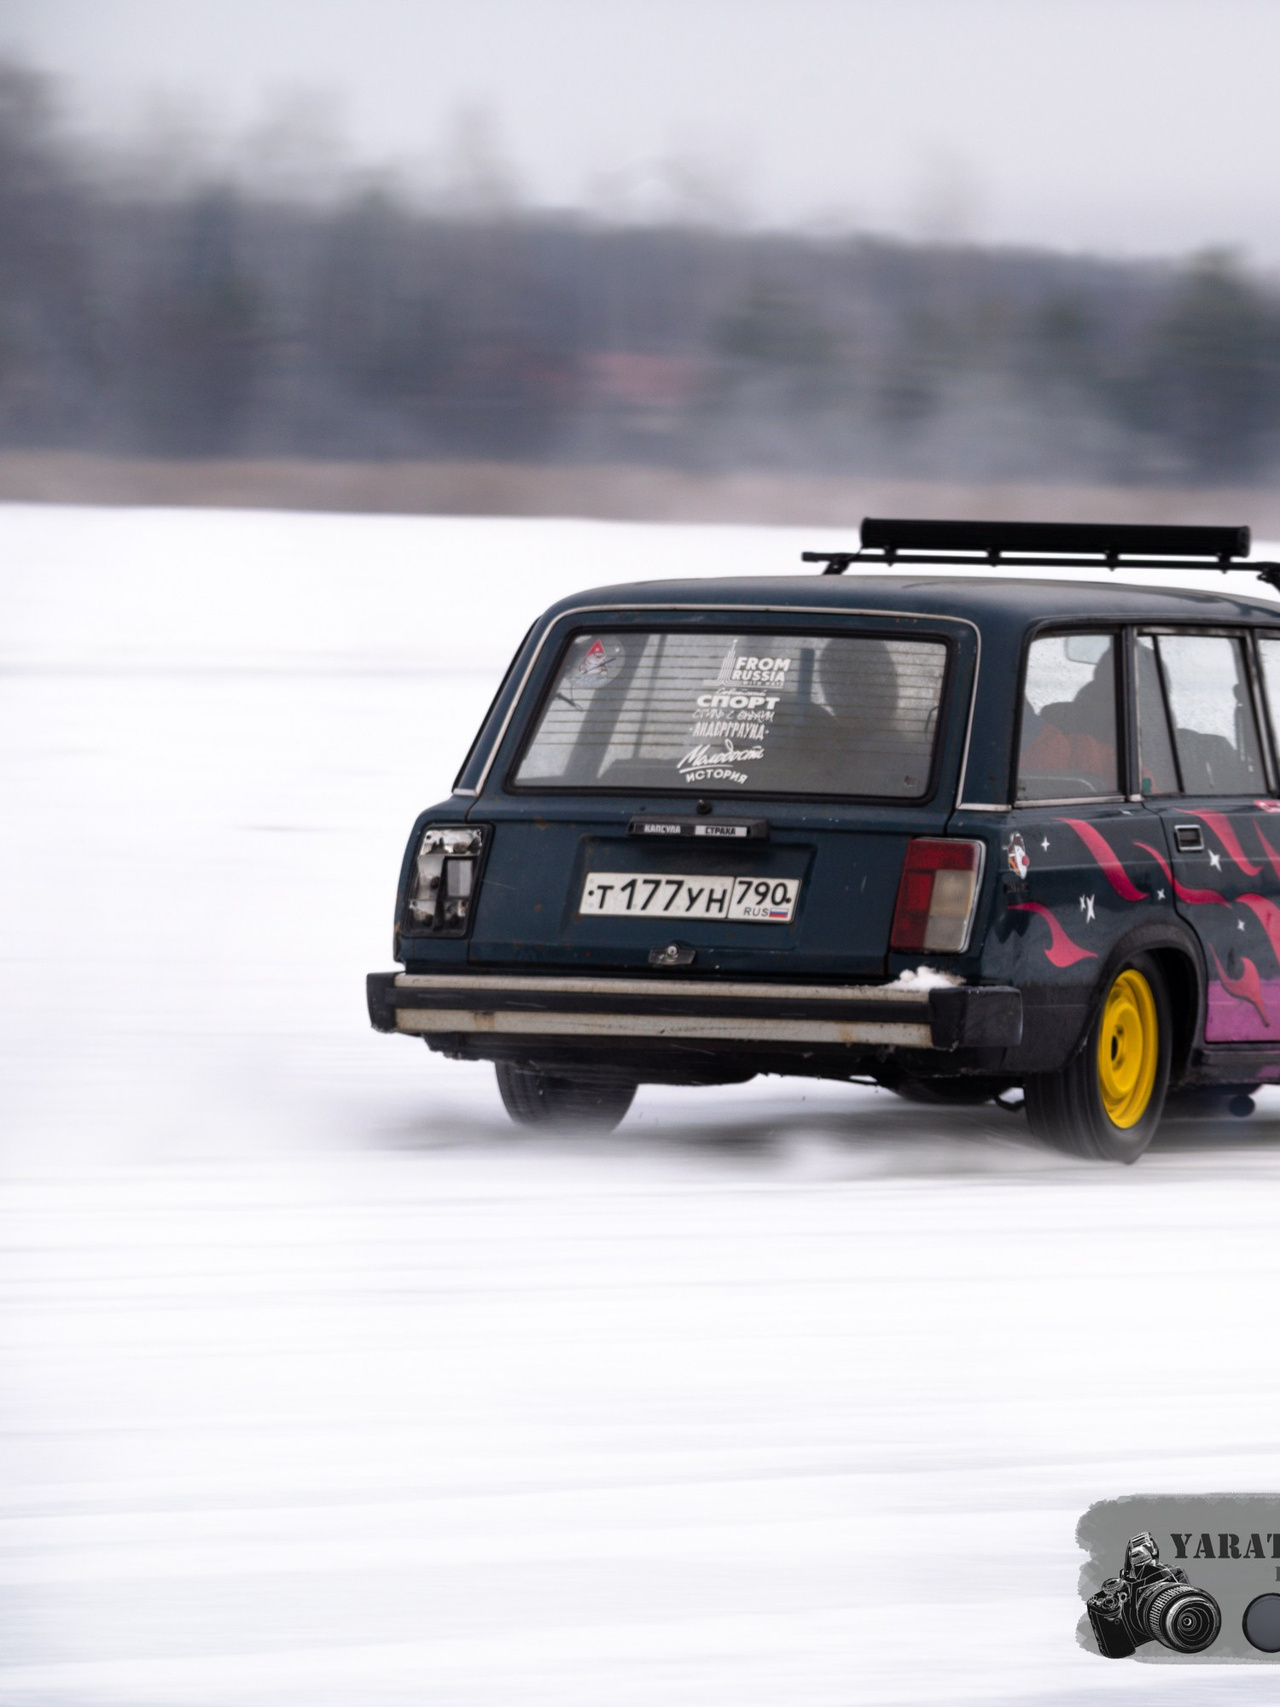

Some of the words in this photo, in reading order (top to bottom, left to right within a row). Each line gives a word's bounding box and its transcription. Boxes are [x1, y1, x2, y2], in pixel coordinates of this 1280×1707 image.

[736, 657, 791, 671] FROM
[732, 670, 785, 682] RUSSIA
[697, 695, 780, 709] СПОРТ
[685, 769, 748, 784] ИСТОРИЯ
[644, 824, 681, 834] КАПСУЛА
[705, 826, 736, 835] СТРАХА
[737, 880, 788, 906] 790
[743, 906, 769, 917] RUS
